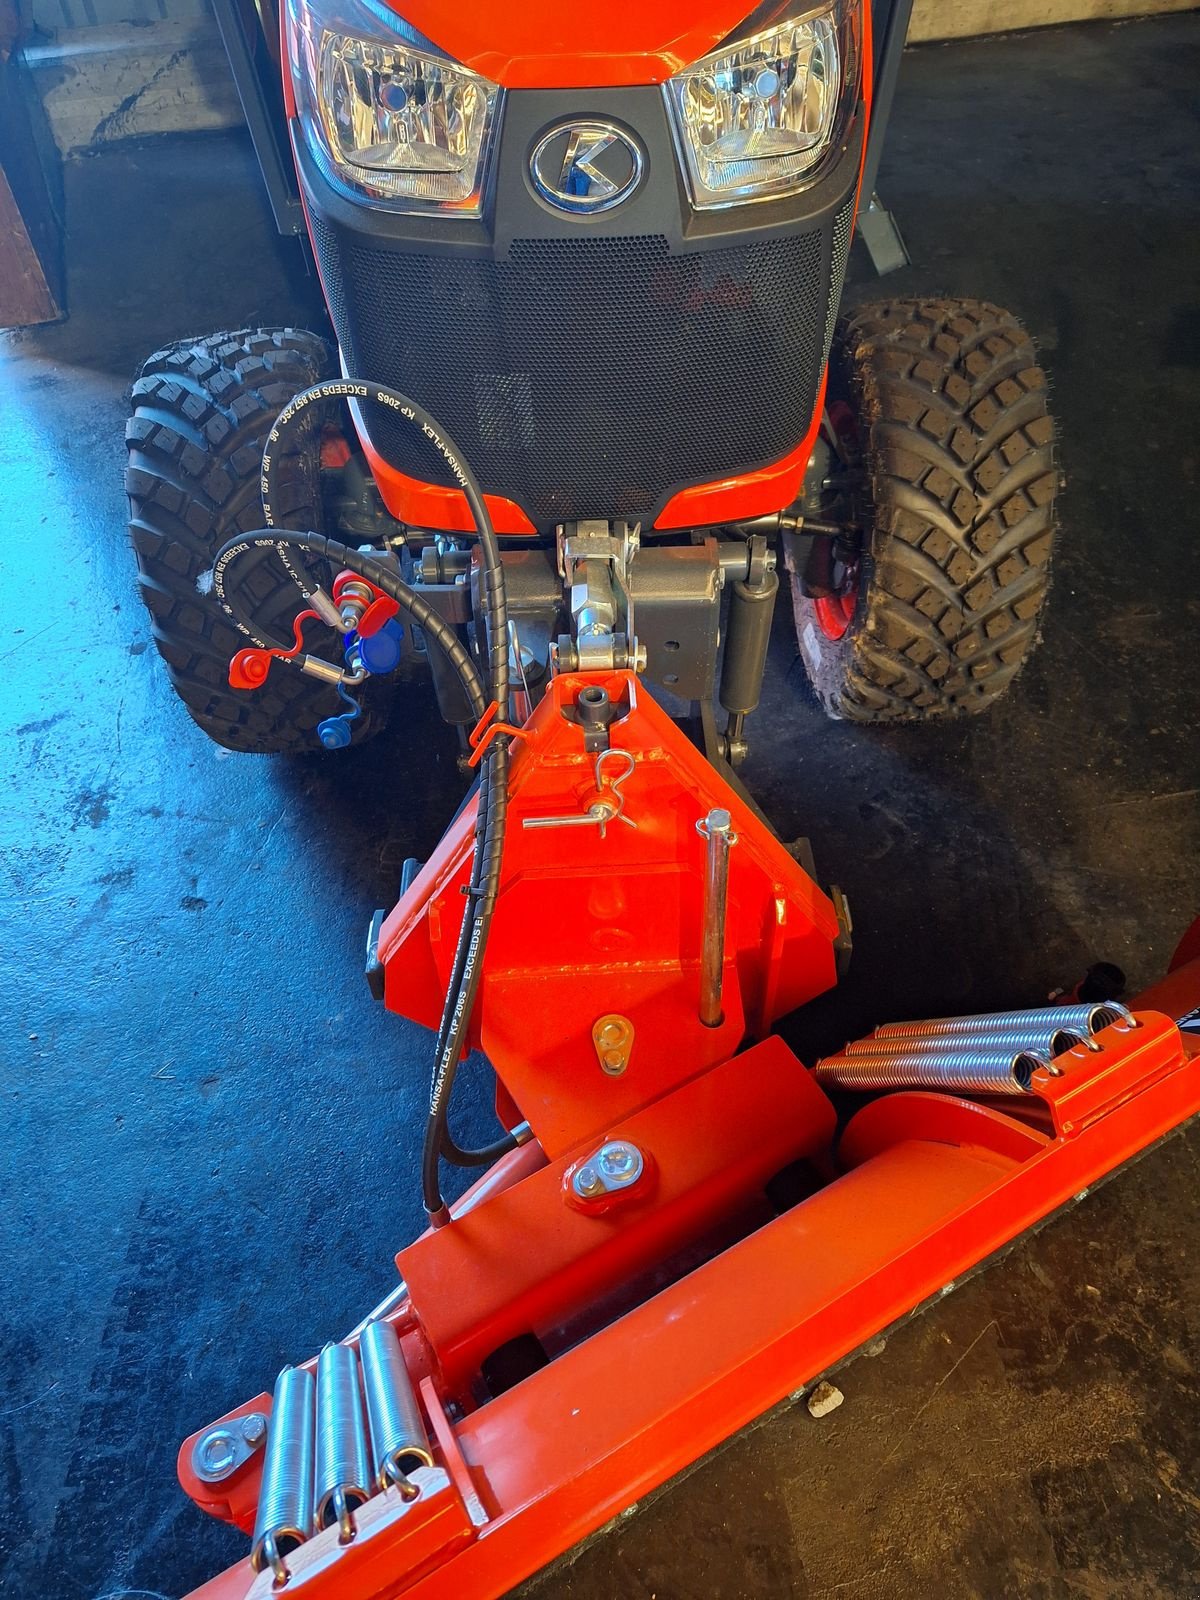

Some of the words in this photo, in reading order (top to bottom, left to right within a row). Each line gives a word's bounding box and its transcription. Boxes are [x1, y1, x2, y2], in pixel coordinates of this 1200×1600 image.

[308, 389, 321, 401] EN
[322, 384, 368, 397] EXCEEDS
[295, 394, 311, 411] 857
[377, 391, 401, 408] 206S
[281, 405, 296, 424] 2SC
[401, 406, 416, 420] KP
[269, 428, 280, 442] 06
[421, 422, 468, 487] HANSA-FLEX
[263, 455, 272, 472] WP
[260, 475, 269, 493] 450
[263, 503, 274, 526] BAR
[220, 542, 250, 564] EXCEEDS
[217, 561, 226, 572] EN
[235, 622, 250, 636] WP
[429, 1046, 453, 1116] HANSA-FLEX
[449, 1019, 459, 1036] KP
[454, 991, 467, 1018] 206S
[463, 928, 481, 979] EXCEEDS
[476, 916, 484, 927] E
